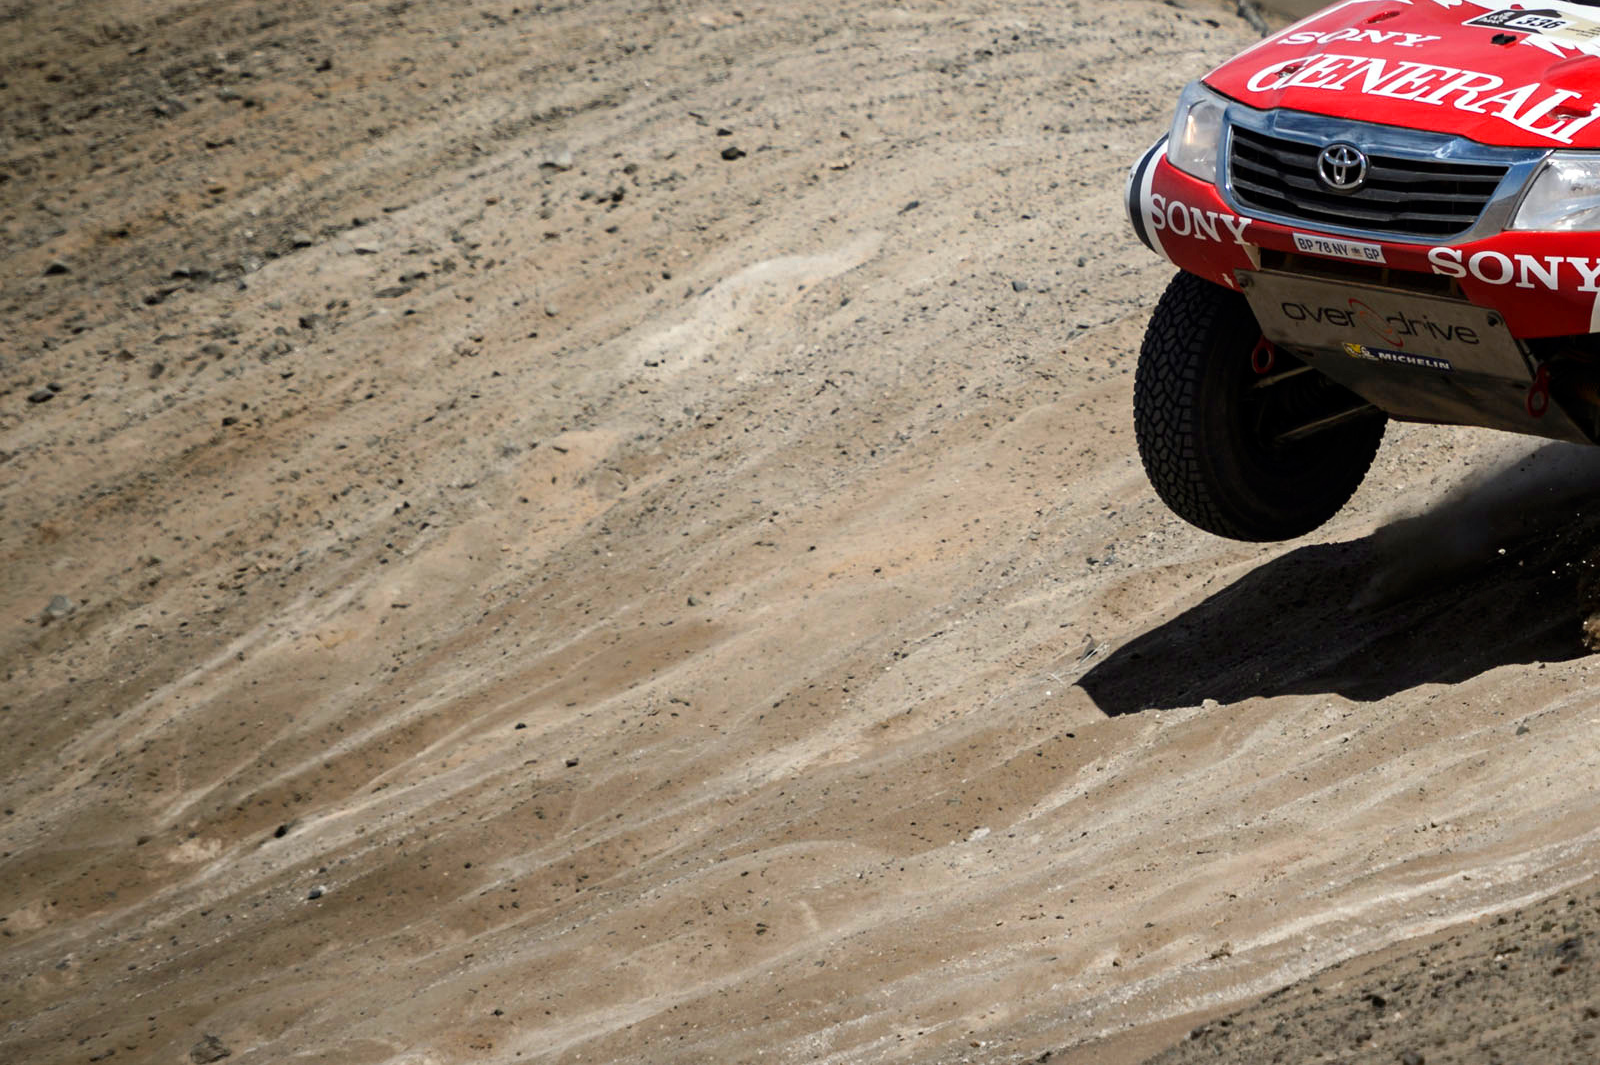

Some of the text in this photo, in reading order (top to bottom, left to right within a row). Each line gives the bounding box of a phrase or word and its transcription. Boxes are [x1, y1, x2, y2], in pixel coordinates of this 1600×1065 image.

[1516, 17, 1567, 29] 336
[1277, 28, 1441, 49] SONY
[1149, 192, 1253, 246] SONY
[1363, 247, 1380, 260] GP
[1378, 352, 1451, 370] MICHELIN
